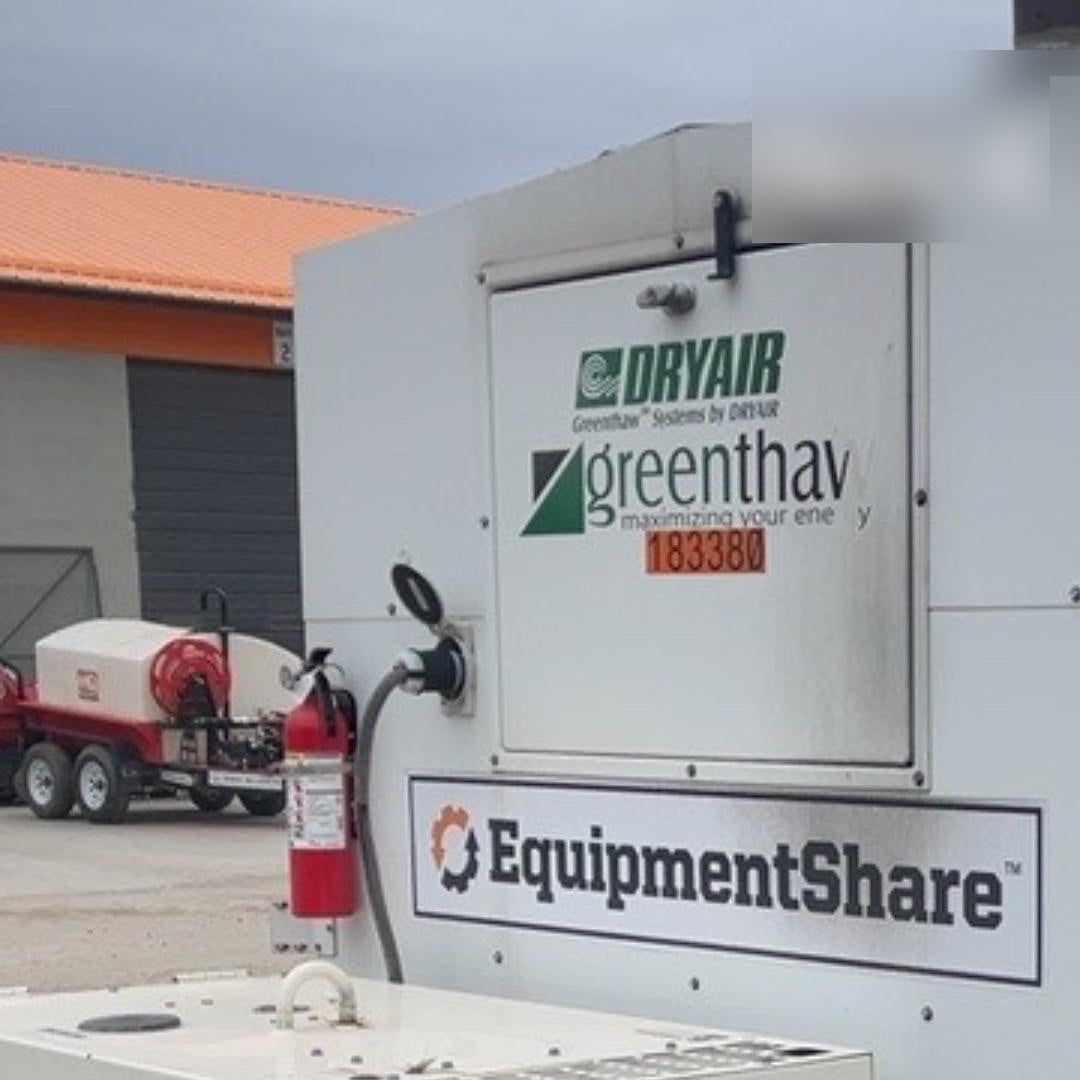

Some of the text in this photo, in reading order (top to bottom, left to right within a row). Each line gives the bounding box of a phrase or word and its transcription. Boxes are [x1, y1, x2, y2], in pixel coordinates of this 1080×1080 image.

[623, 330, 786, 406] DRYAIR
[652, 407, 706, 428] Systems
[709, 404, 725, 425] by
[740, 507, 789, 528] your
[648, 529, 765, 573] 183380
